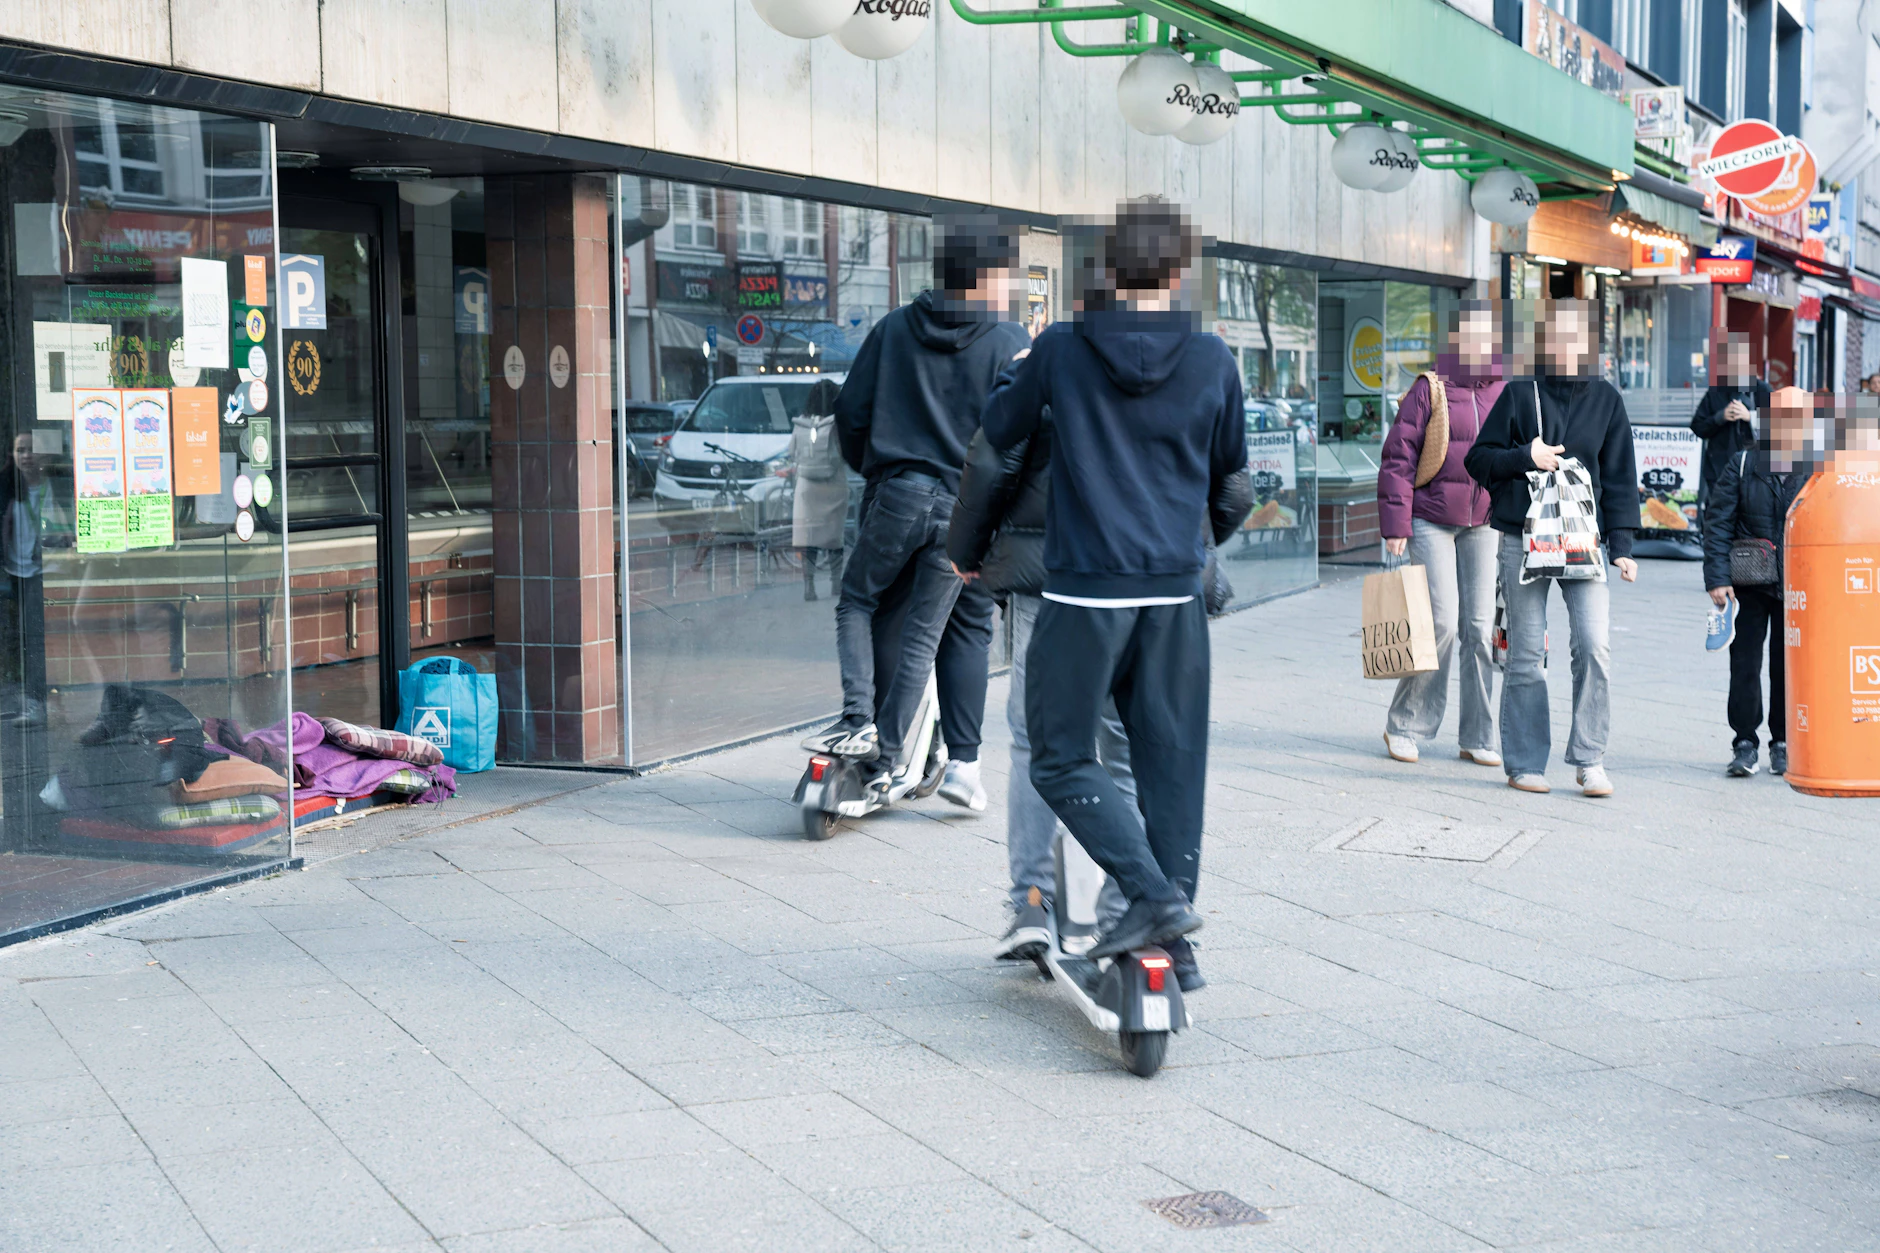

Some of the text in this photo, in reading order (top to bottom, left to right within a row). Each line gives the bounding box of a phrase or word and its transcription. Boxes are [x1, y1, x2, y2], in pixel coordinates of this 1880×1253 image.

[1702, 139, 1794, 175] WIECZOREK
[1711, 240, 1743, 259] sky
[1707, 266, 1740, 277] sport
[288, 271, 315, 327] P
[297, 358, 313, 377] 90
[86, 432, 111, 448] Live
[135, 432, 159, 447] Live
[1632, 428, 1699, 443] Seelachsfilet
[1643, 456, 1688, 467] AKTION
[1649, 472, 1676, 486] 9.90
[1361, 618, 1411, 650] VERO
[1362, 645, 1415, 677] MODA
[1851, 698, 1877, 706] Service
